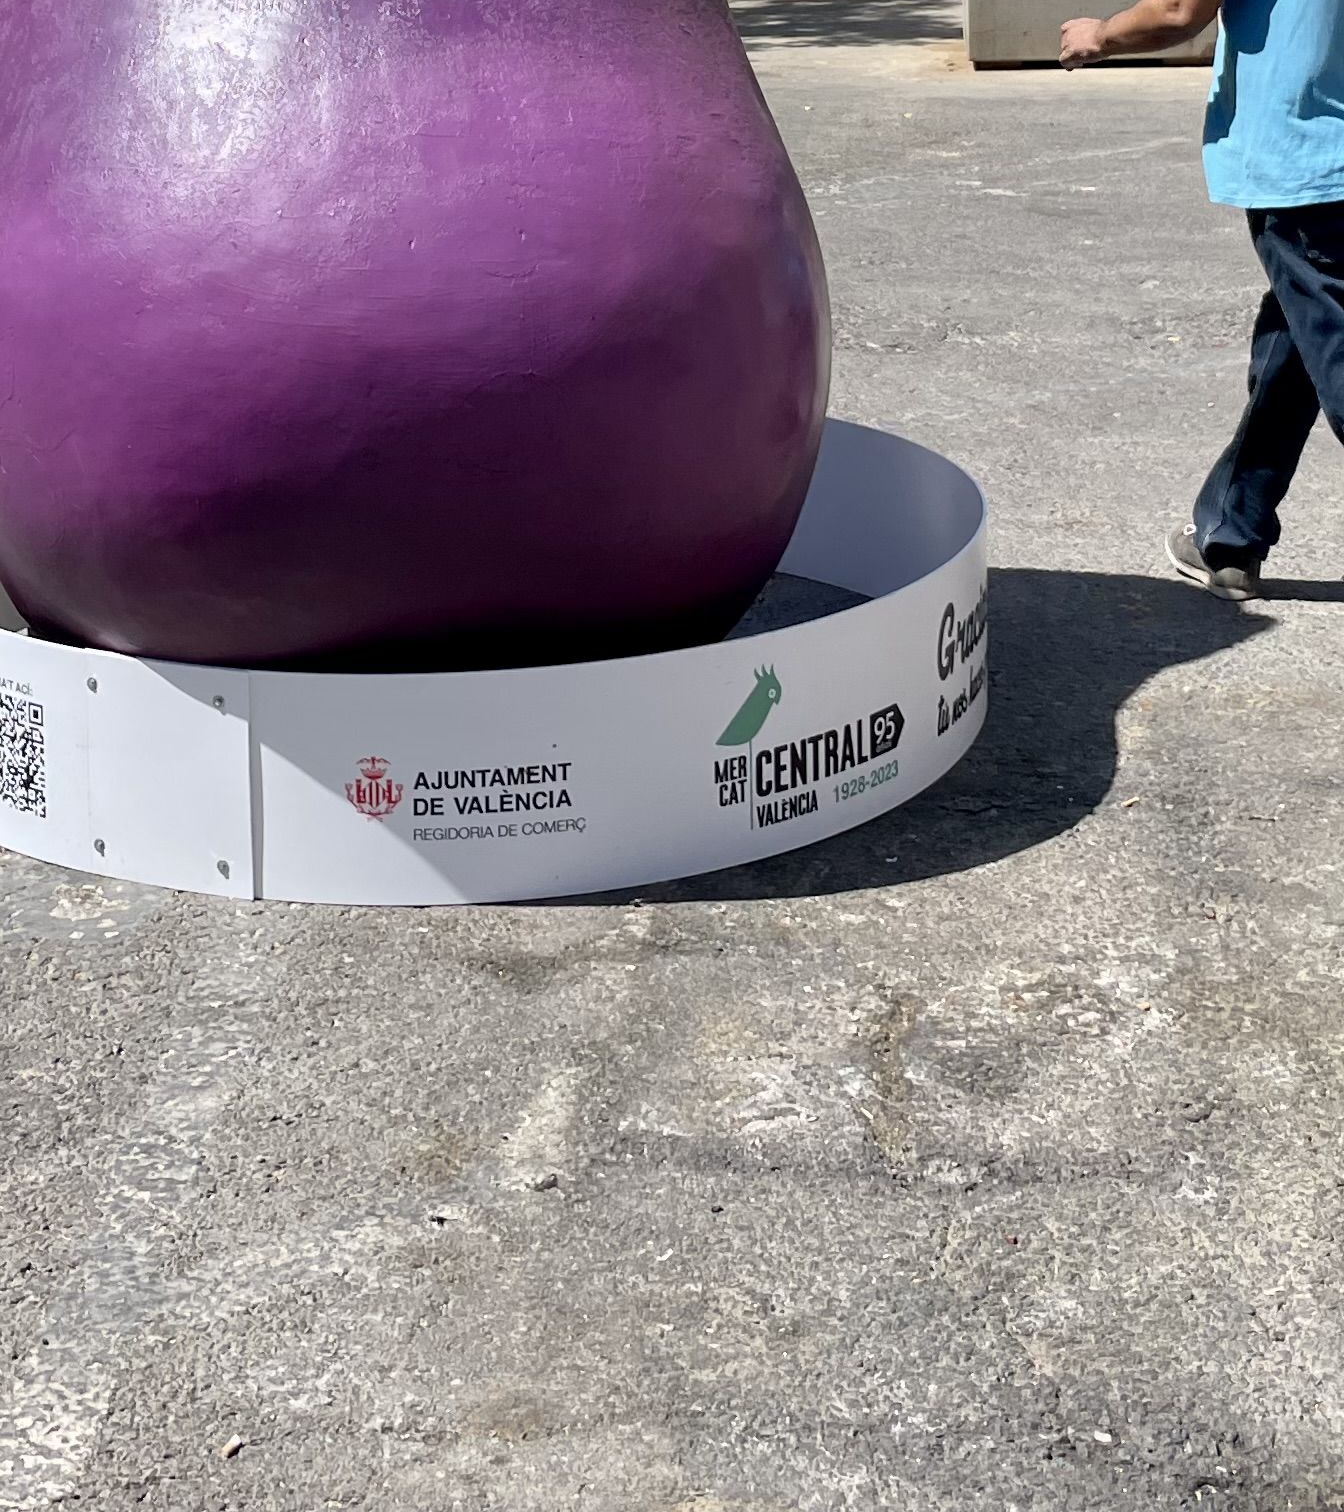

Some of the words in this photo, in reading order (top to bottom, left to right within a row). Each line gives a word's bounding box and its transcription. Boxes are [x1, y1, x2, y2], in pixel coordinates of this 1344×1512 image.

[714, 755, 747, 784] MER
[755, 719, 869, 797] CENTRAL
[874, 710, 895, 745] 95
[413, 762, 572, 790] AJUNTAMENT
[413, 797, 445, 816] DE
[453, 789, 572, 815] VALÈNCIA
[718, 779, 746, 807] CAT
[756, 789, 819, 828] VALÈNCIA
[832, 760, 899, 803] 1928-2023
[413, 824, 494, 841] REGIDORIA
[497, 823, 518, 837] DE
[521, 817, 587, 836] COMERÇ
